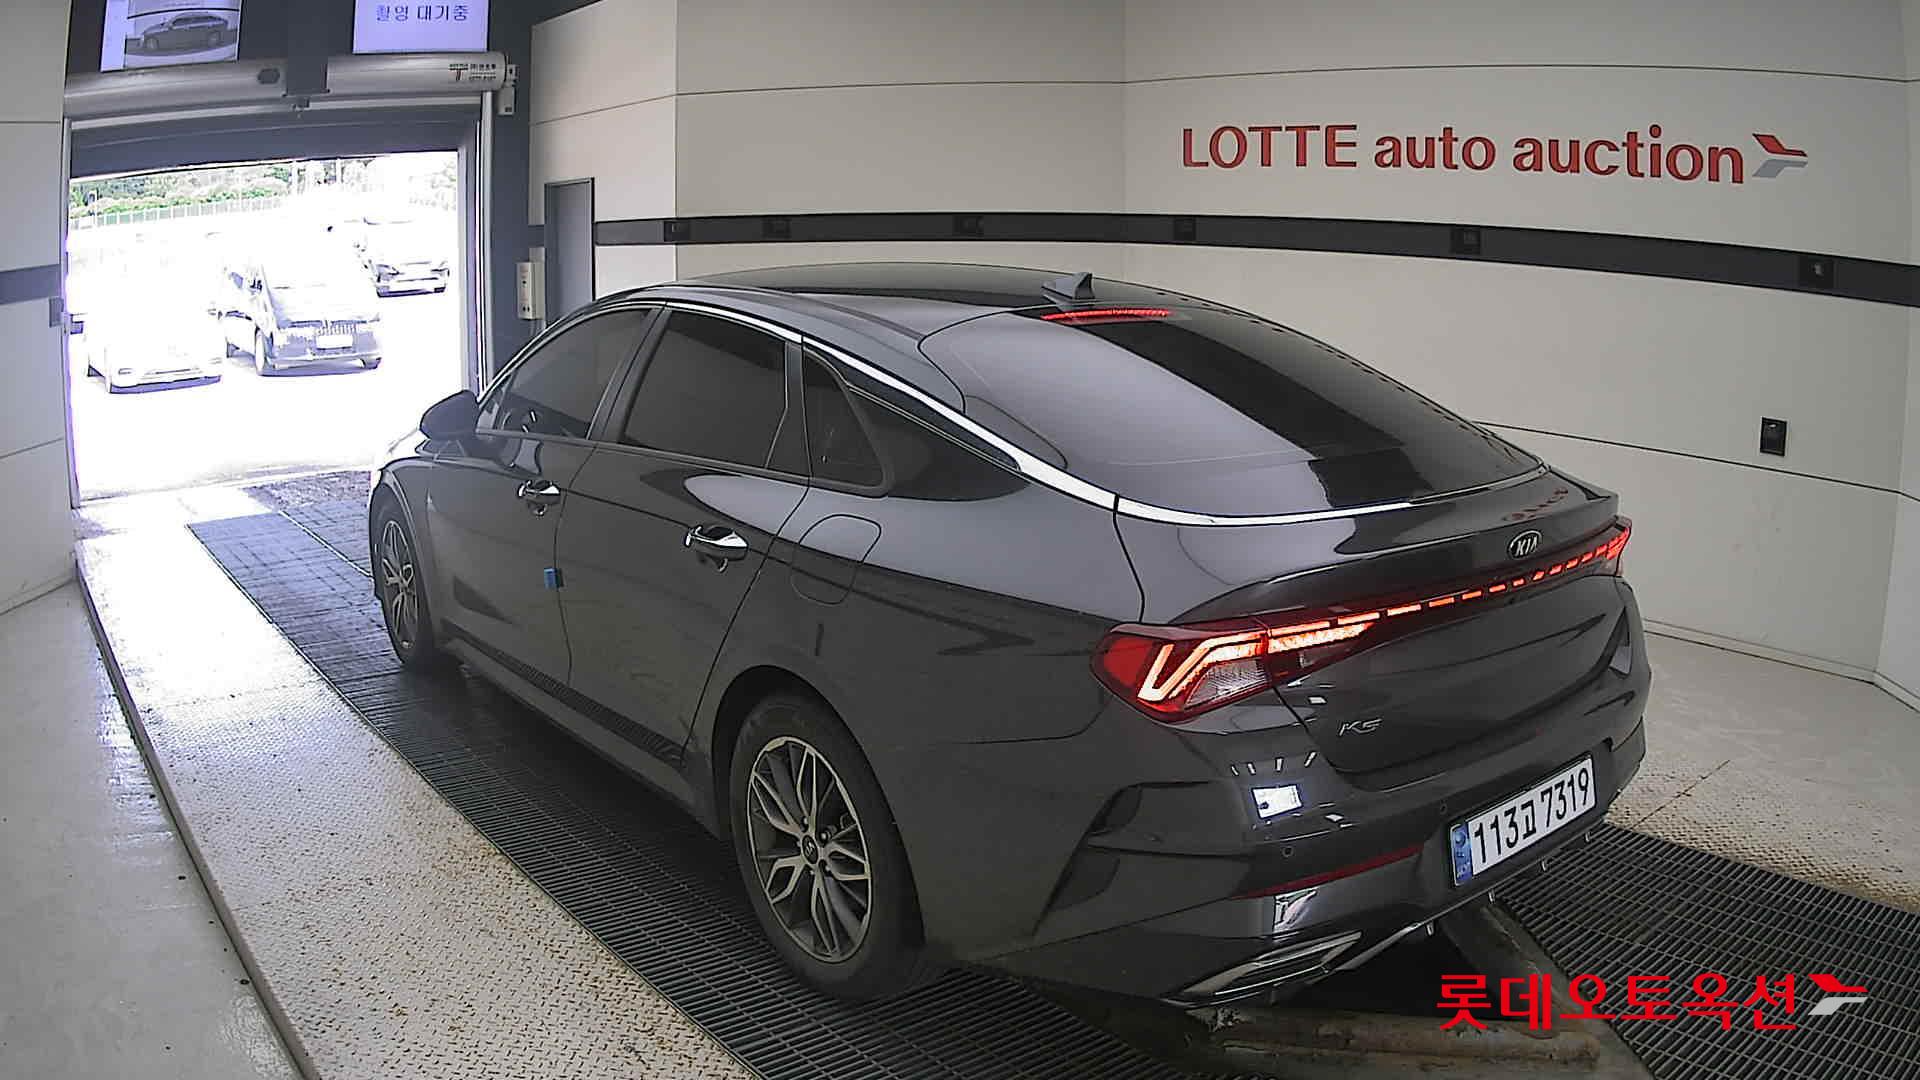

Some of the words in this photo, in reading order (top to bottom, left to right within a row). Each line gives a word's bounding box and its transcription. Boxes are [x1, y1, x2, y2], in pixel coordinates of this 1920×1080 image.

[417, 5, 469, 21] 대기중
[1182, 124, 1358, 169] LOTTE
[1374, 126, 1497, 171] auto
[1512, 123, 1744, 184] auction
[1514, 534, 1538, 557] KIA
[1338, 718, 1382, 737] K5
[1540, 767, 1590, 828] 7319
